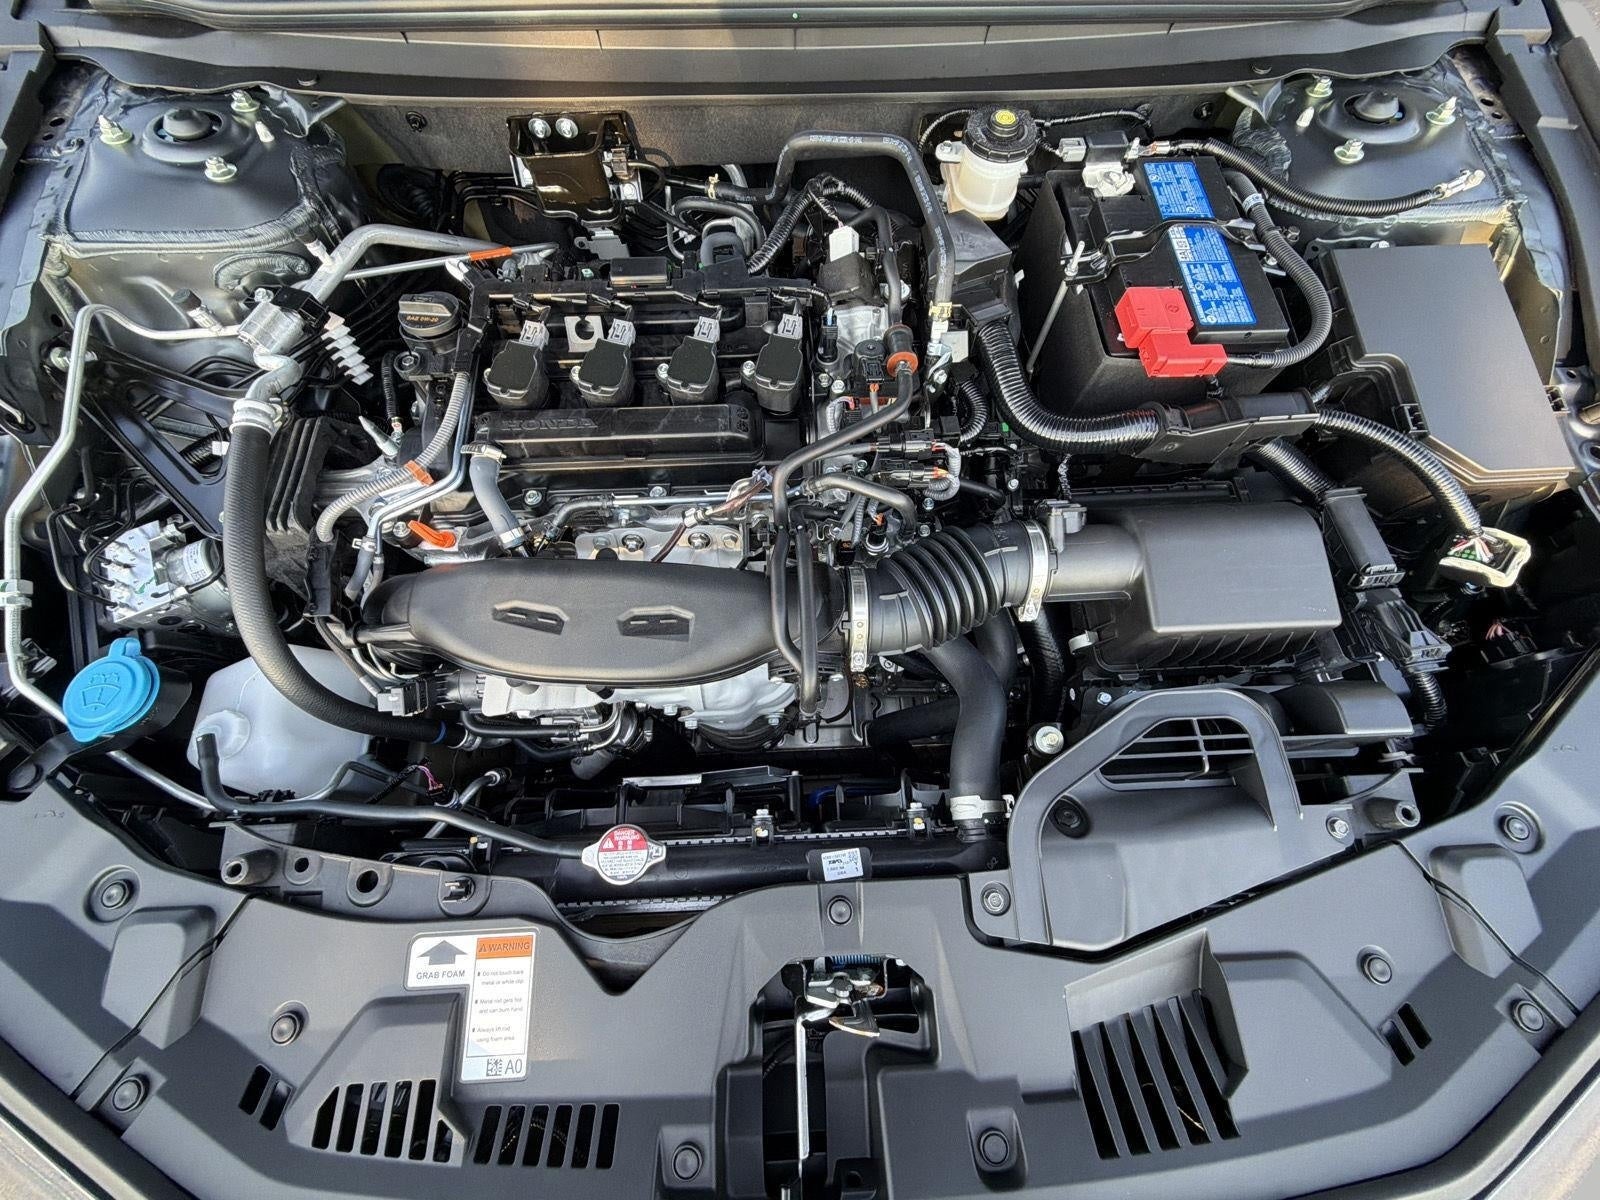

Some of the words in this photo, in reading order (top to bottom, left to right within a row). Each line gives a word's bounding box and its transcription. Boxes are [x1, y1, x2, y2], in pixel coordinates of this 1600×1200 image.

[501, 418, 599, 431] HONDA
[488, 942, 531, 952] WARNING
[416, 970, 440, 980] GRAB
[441, 969, 466, 979] FOAM
[504, 1058, 523, 1075] A0
